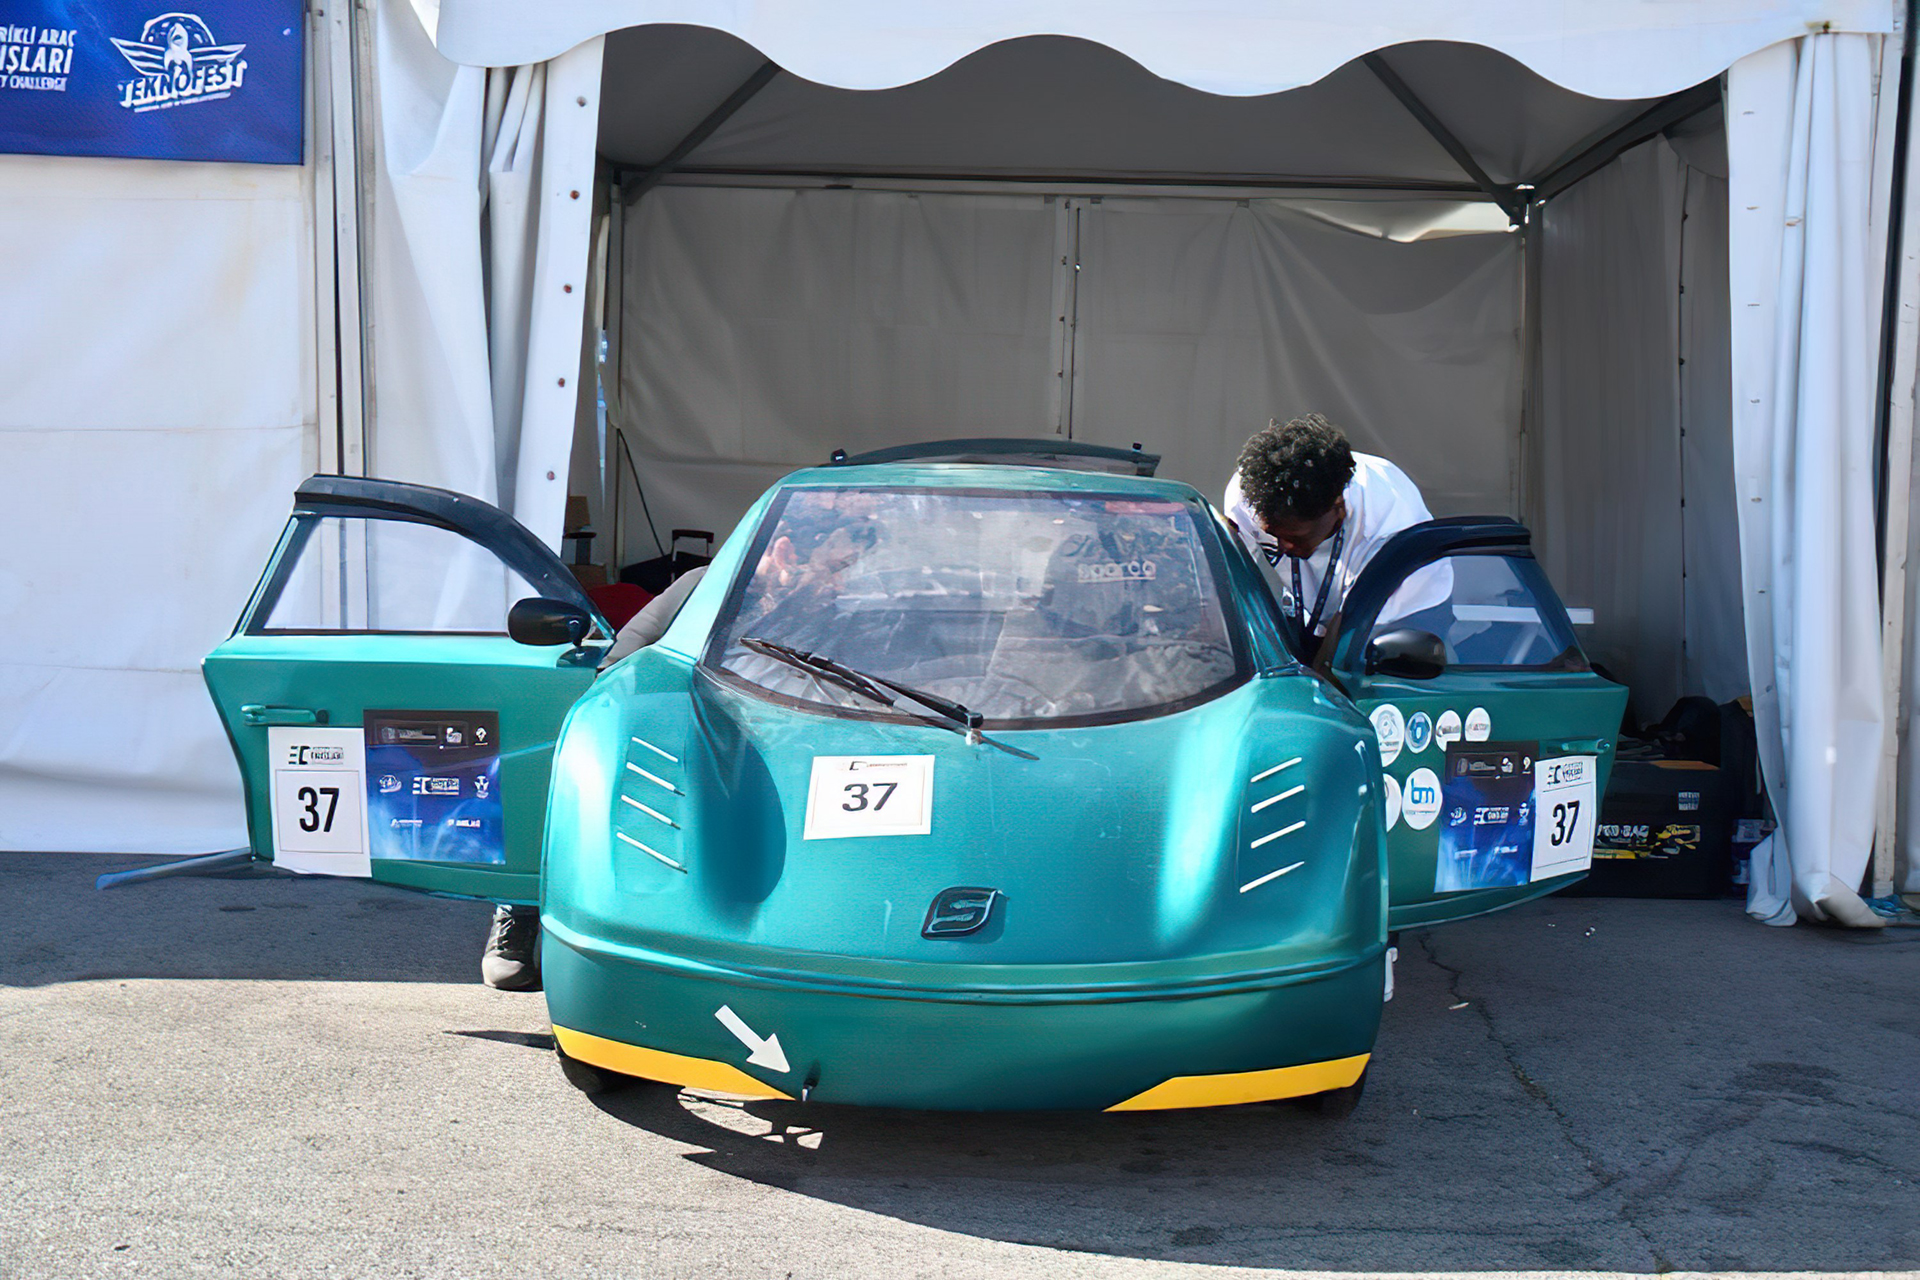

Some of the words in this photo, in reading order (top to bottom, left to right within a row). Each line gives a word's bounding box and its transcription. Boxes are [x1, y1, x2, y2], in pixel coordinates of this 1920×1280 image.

[117, 59, 248, 108] TEKNOFEST
[298, 786, 339, 832] 37
[842, 782, 898, 812] 37
[1551, 800, 1580, 846] 37
